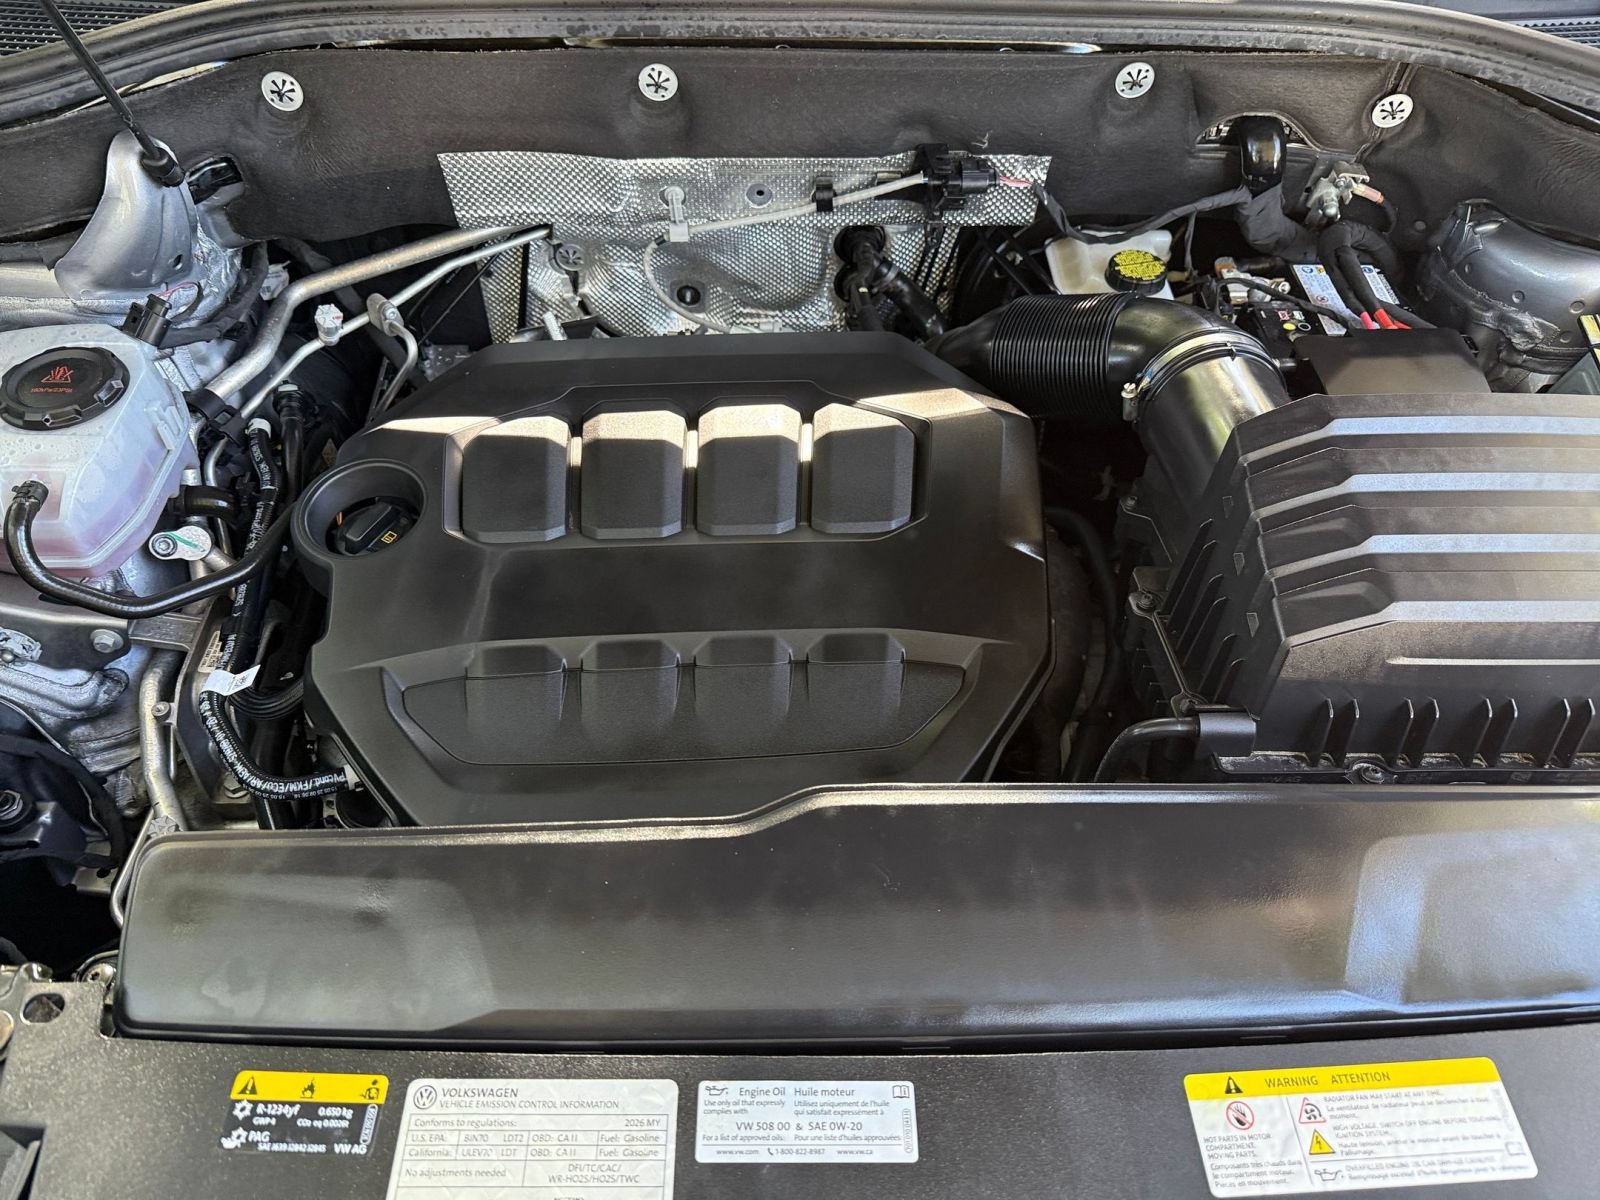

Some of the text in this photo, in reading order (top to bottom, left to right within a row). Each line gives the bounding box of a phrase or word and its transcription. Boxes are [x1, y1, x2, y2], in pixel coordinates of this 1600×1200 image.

[1264, 1071, 1391, 1088] WARNING ATTENTION
[442, 1088, 519, 1098] VOLKSWAGEN
[739, 1087, 786, 1099] Engine Oil
[794, 1087, 855, 1097] Huile moteur
[440, 1100, 620, 1109] VEHICLE EMISSION CONTROL INFORMATION
[717, 1100, 731, 1108] only
[756, 1100, 785, 1108] expressly
[819, 1101, 859, 1109] uniquement
[256, 1103, 301, 1118] R-1234yf
[414, 1118, 517, 1129] Conforms to regulations:
[624, 1118, 661, 1127] 2026 MY
[736, 1121, 863, 1131] VW 508 00 & SAE 0W-20
[248, 1130, 271, 1142] PAG
[600, 1134, 660, 1143] Fuel: Gasoline
[740, 1134, 770, 1142] approved
[334, 1143, 368, 1155] VW AG
[599, 1148, 659, 1157] Fuel: Gasoline
[405, 1168, 507, 1179] No adjustments needed
